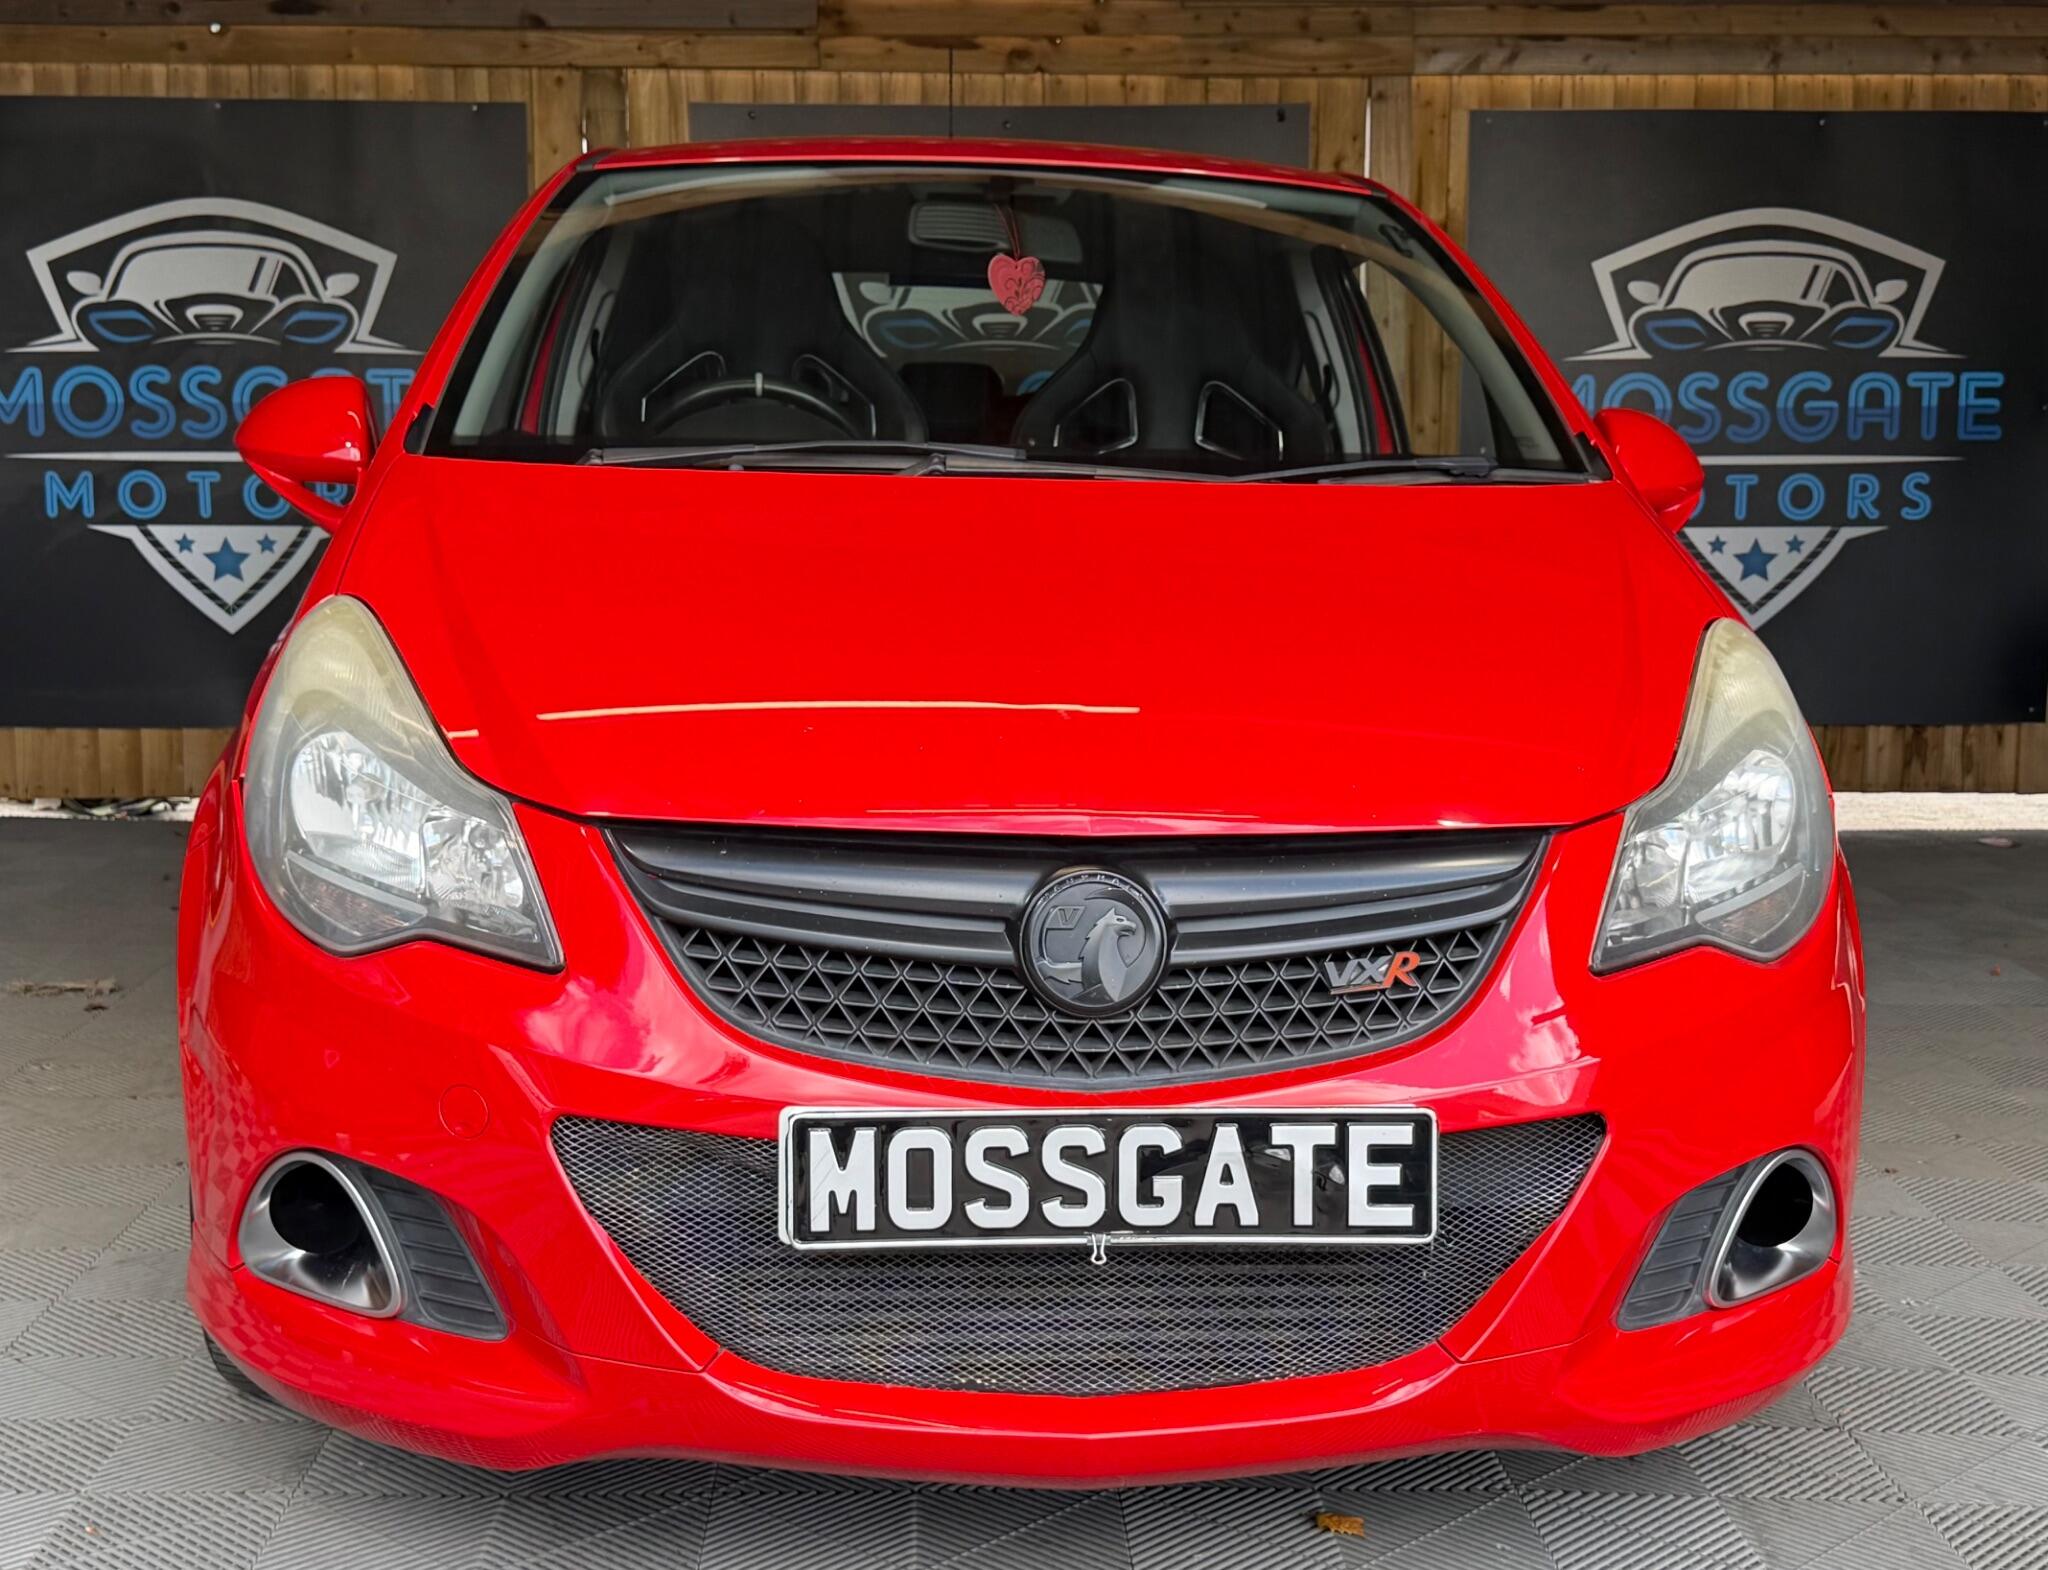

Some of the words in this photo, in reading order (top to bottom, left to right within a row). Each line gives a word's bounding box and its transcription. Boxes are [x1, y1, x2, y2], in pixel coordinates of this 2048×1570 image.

[0, 365, 415, 440] MOSST
[1691, 472, 1933, 521] TORS
[1324, 951, 1421, 988] VXR
[808, 1122, 1415, 1232] MOSSGATE
